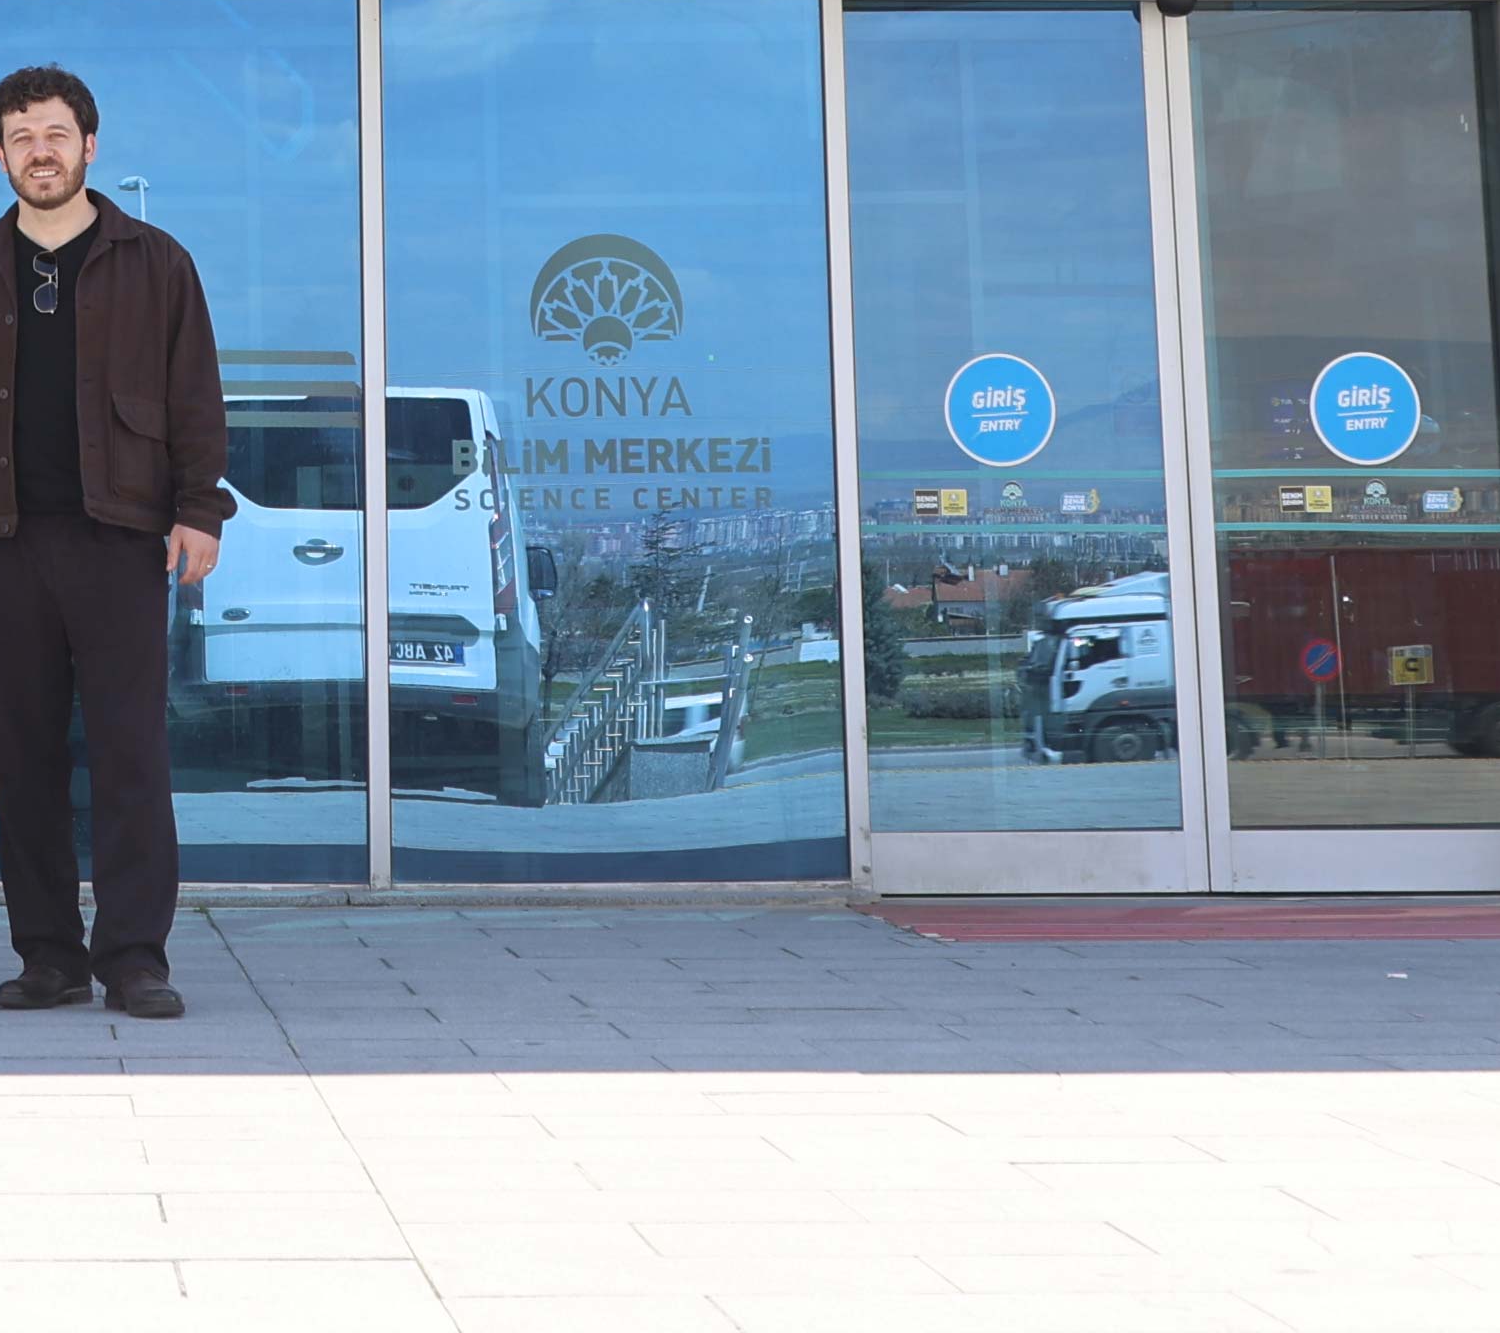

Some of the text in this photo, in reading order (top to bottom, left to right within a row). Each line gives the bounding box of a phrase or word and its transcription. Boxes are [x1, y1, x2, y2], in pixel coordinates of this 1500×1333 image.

[526, 376, 692, 417] KONYA
[972, 385, 1026, 411] GİRİŞ
[1337, 384, 1391, 409] GİRİŞ
[980, 419, 1022, 432] ENTRY
[1346, 417, 1388, 431] ENTRY
[454, 487, 773, 511] SCIENCE CENTER
[1363, 497, 1391, 505] KONYA
